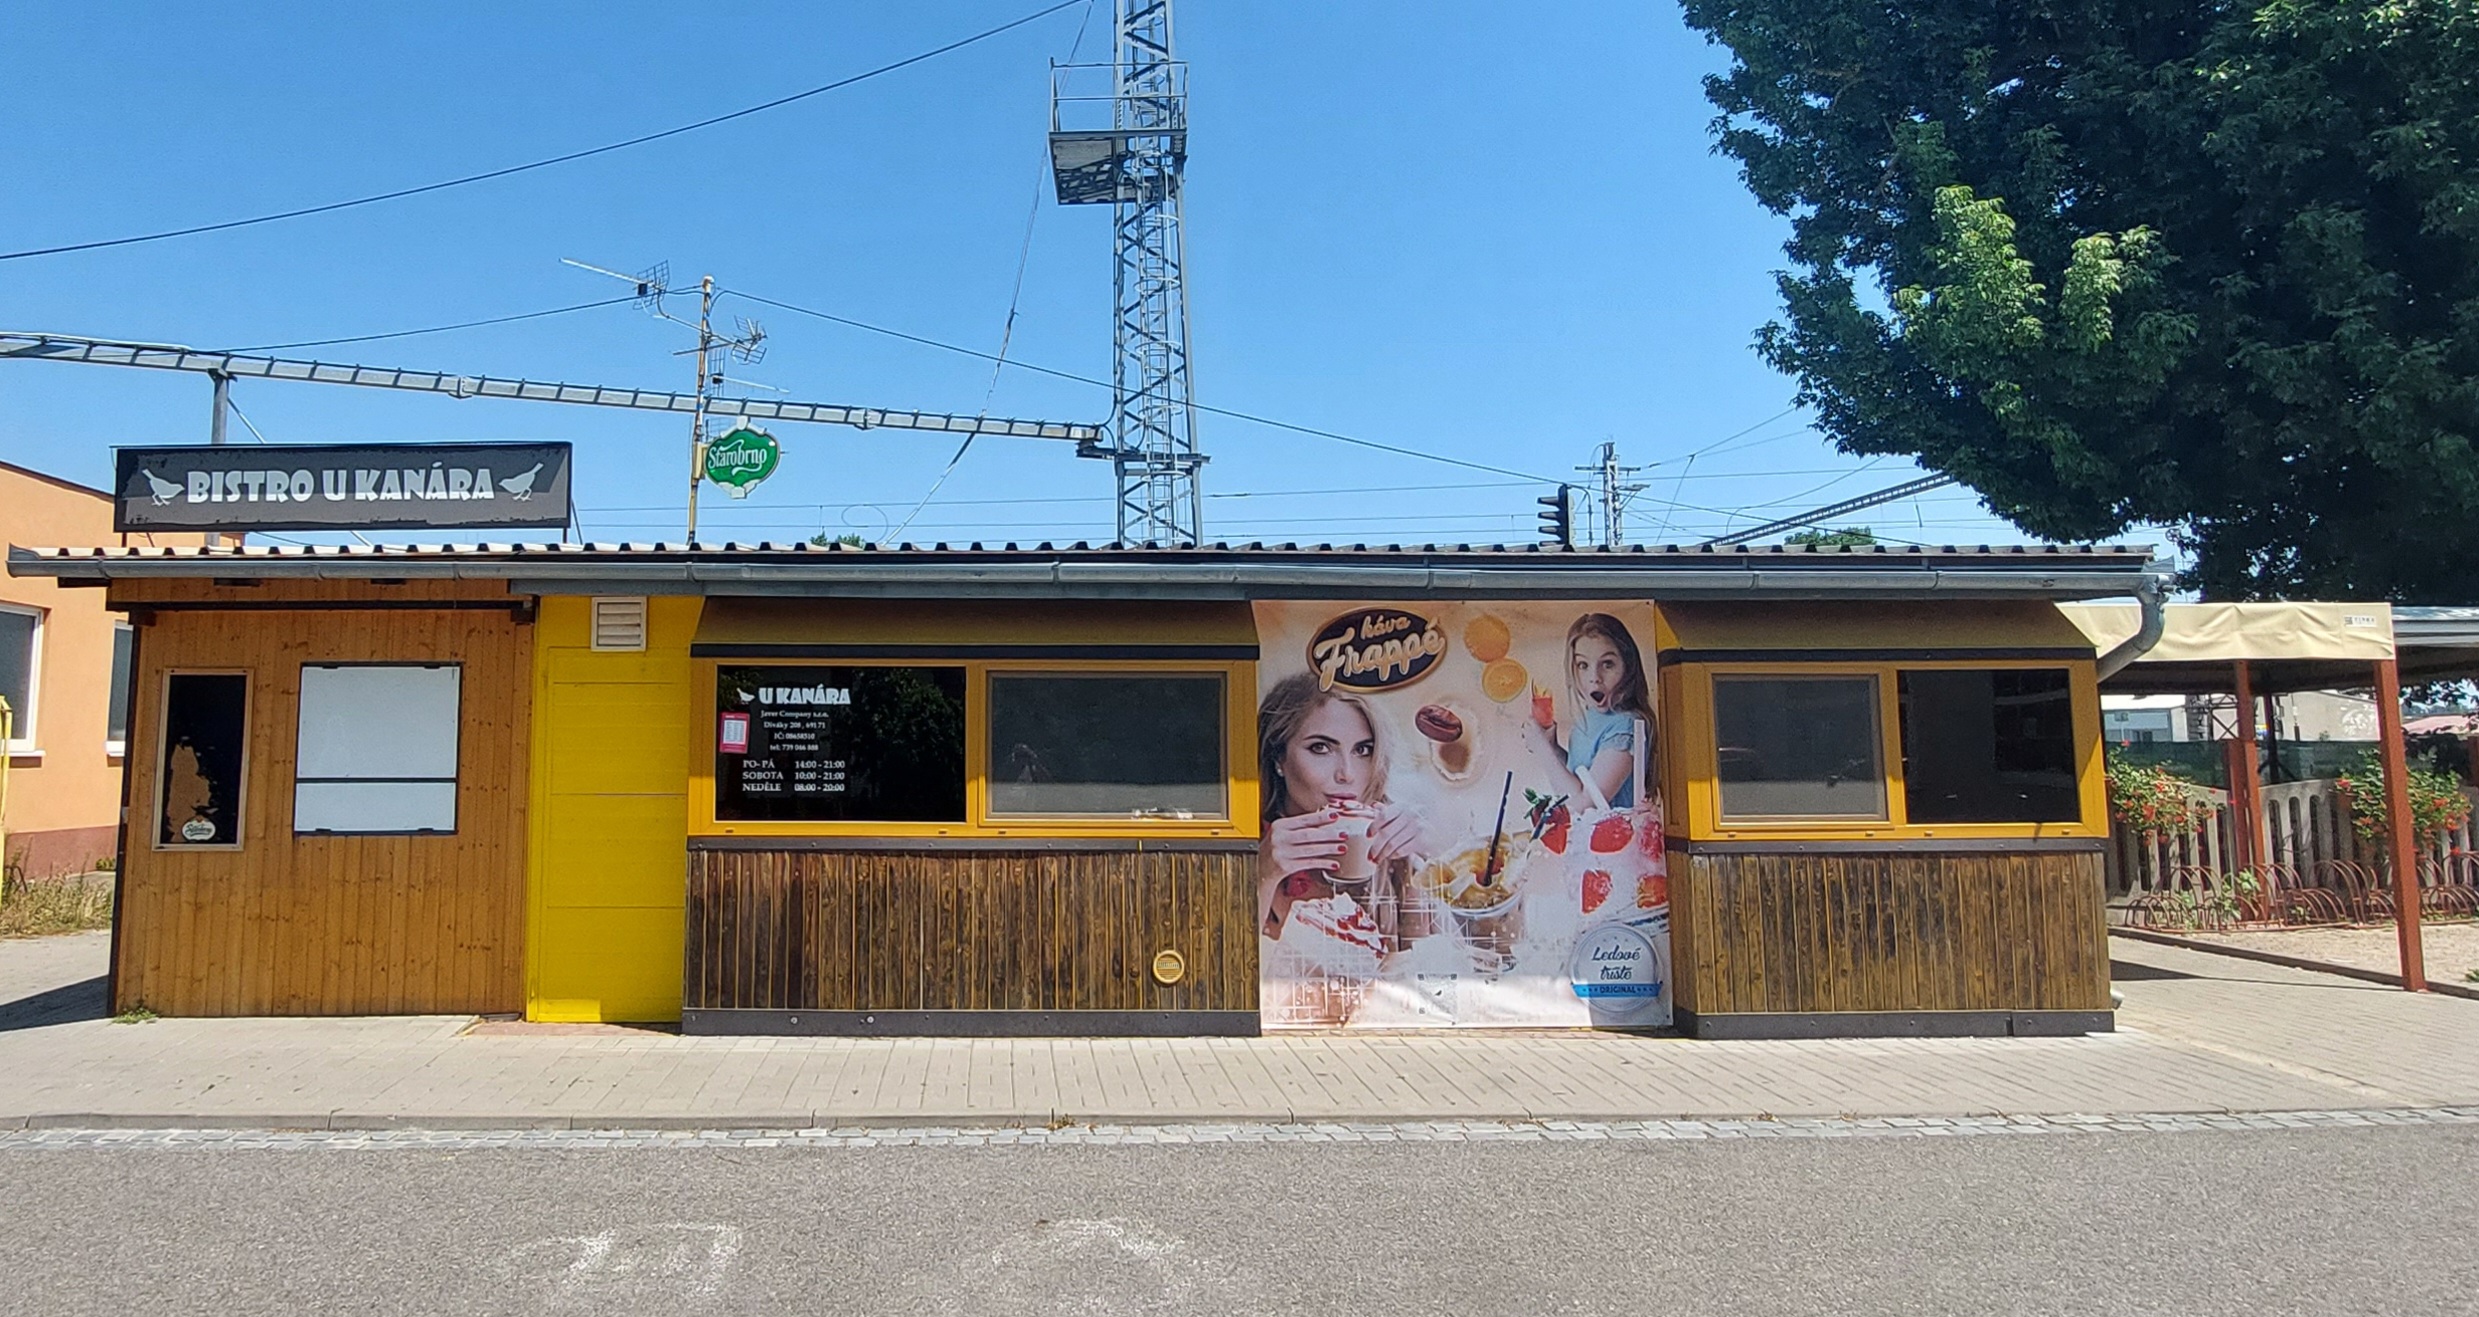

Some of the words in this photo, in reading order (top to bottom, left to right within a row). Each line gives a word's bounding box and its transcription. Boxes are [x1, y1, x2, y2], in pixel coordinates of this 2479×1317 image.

[708, 439, 767, 476] Starobrno
[187, 469, 314, 503] BISTRO
[323, 469, 348, 501] U
[355, 461, 495, 502] KANÁRA
[1361, 614, 1411, 640] káva
[1313, 617, 1446, 692] Frappé
[759, 687, 774, 705] U
[776, 683, 851, 705] KANÁRA
[779, 710, 812, 719] Company
[795, 760, 817, 769] 14:00
[823, 760, 846, 769] 21:00
[742, 771, 784, 780] SOBOTA
[795, 771, 816, 780] 10:00
[823, 771, 845, 780] 21:00
[742, 781, 782, 792] NEDĚLE
[794, 783, 816, 792] 08:00
[822, 783, 845, 792] 20:00
[1591, 944, 1641, 961] Ledové
[1600, 986, 1636, 994] ORIGINAL
